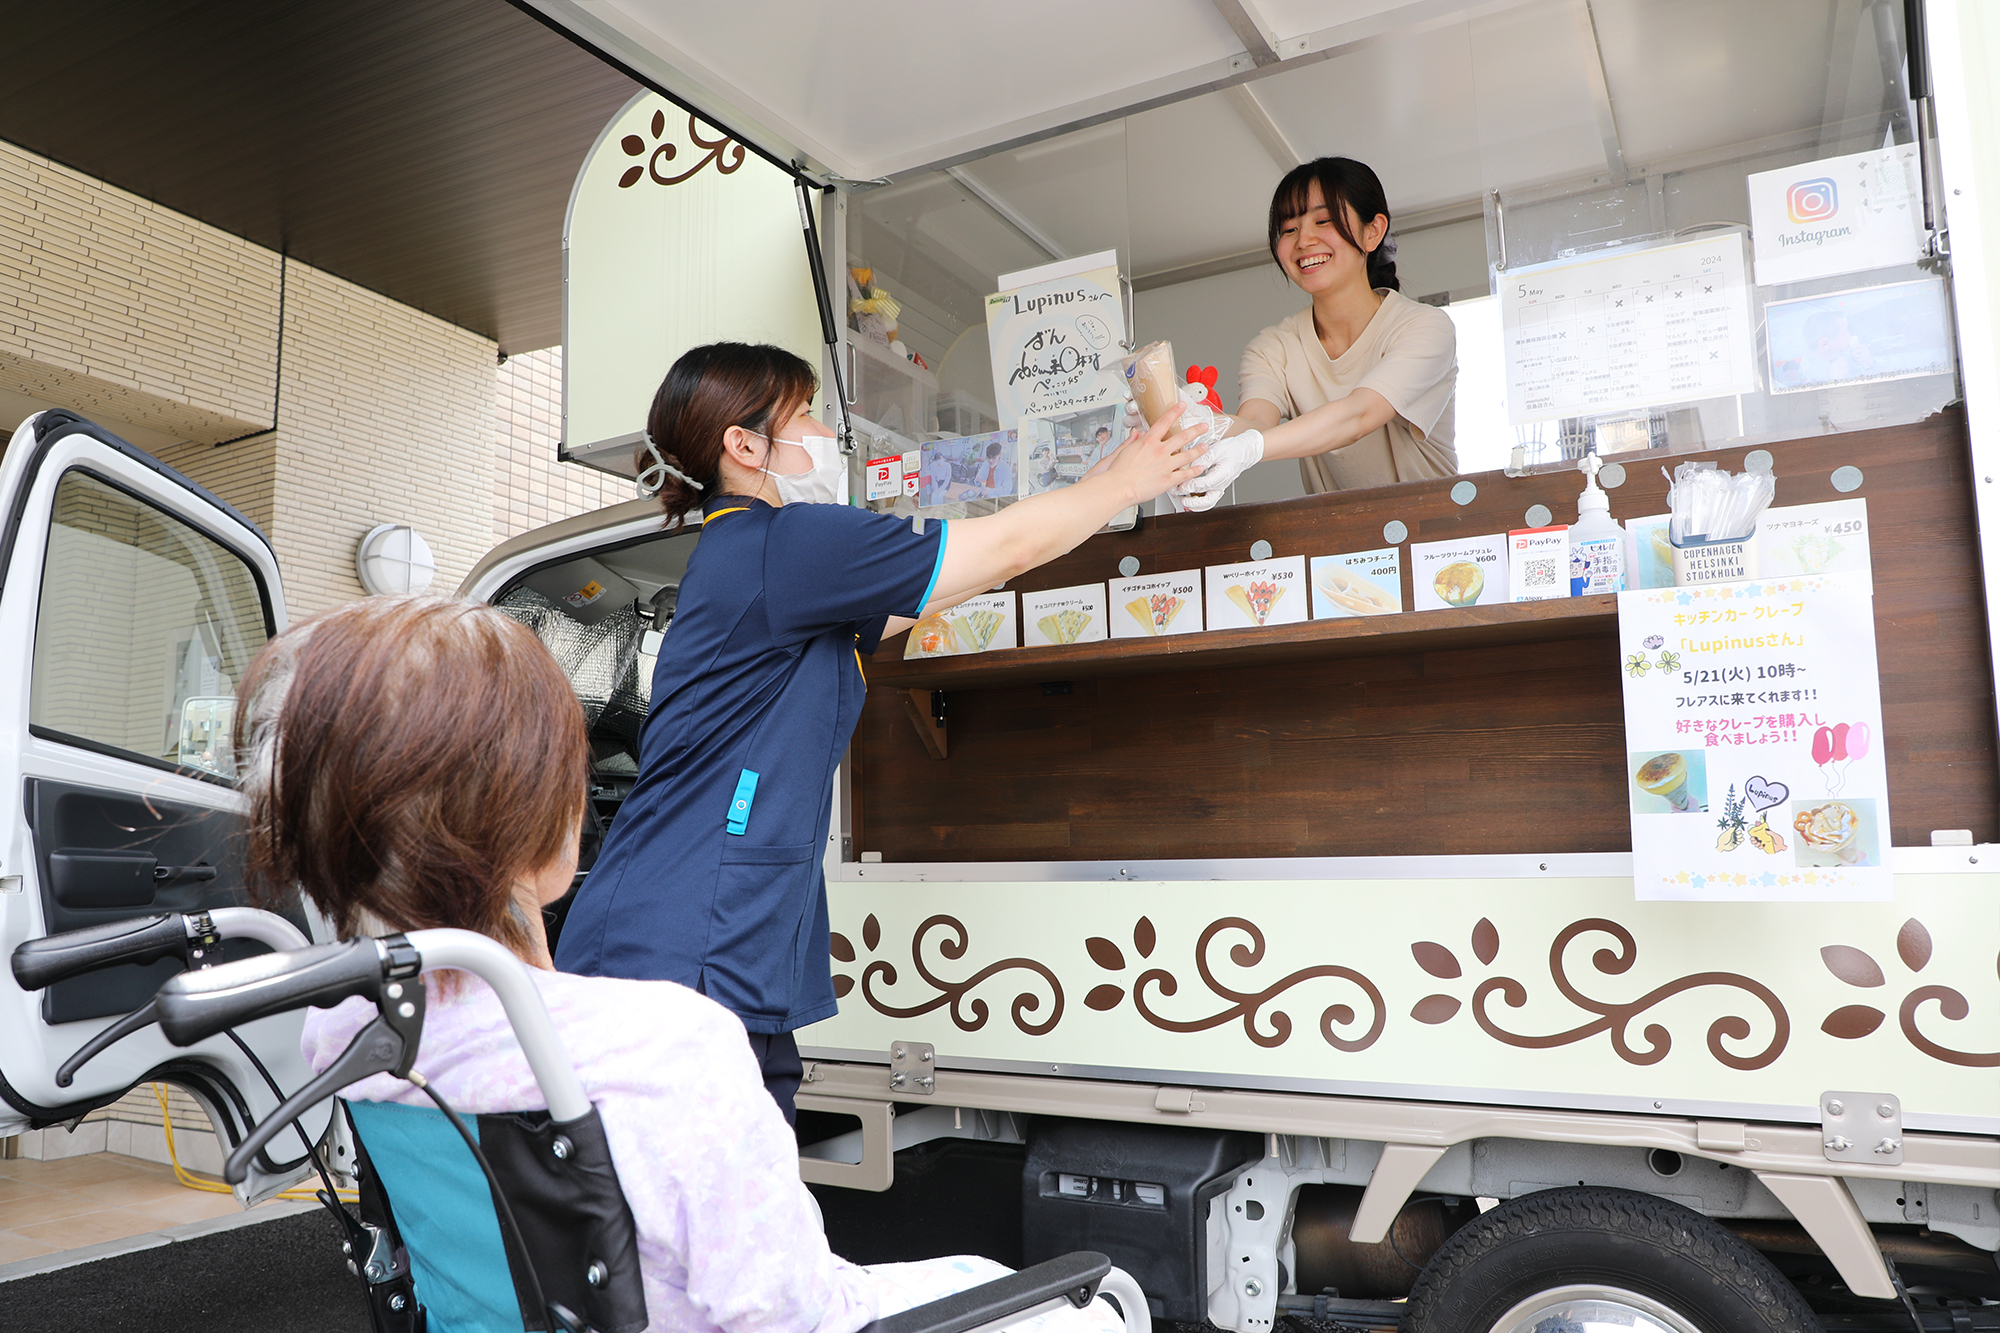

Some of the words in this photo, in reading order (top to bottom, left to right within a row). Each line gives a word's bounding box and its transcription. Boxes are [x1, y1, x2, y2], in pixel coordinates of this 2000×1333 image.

[1778, 226, 1852, 247] Instagram
[1701, 255, 1722, 266] 2024
[1518, 283, 1527, 299] 5
[1529, 288, 1544, 297] May
[1024, 328, 1066, 351] ずん
[875, 480, 893, 488] PayPay
[1766, 518, 1819, 530] ツナマヨネーズ
[1824, 520, 1863, 535] ¥450
[1529, 537, 1562, 547] PayPay
[1345, 553, 1395, 566] はちみつチーズ
[1423, 548, 1493, 561] フルーツクリームブリュレ
[1475, 554, 1497, 563] ¥600
[1683, 544, 1743, 560] COPENHAGEN
[1690, 556, 1739, 570] HELSINKI
[1223, 568, 1267, 579] Wベリーホイップ
[1271, 571, 1294, 581] ¥530
[1370, 566, 1397, 576] 400円
[1686, 567, 1745, 582] STOCKHOLM
[1121, 581, 1171, 593] イチゴチョコホイップ
[1172, 585, 1194, 595] ¥500
[1673, 608, 1748, 627] キッチンカー
[1752, 601, 1805, 620] クレープ
[1679, 632, 1804, 655] 「Lupinusさん」
[1682, 664, 1752, 686] 5/21(火)
[1675, 688, 1818, 709] フレアスに来てくれます!!
[1676, 711, 1827, 734] 好きなクレープを購入し
[1704, 729, 1798, 748] 食べましょう!!
[1748, 783, 1779, 804] Lupinus
[1466, 1260, 1512, 1294] VAN
